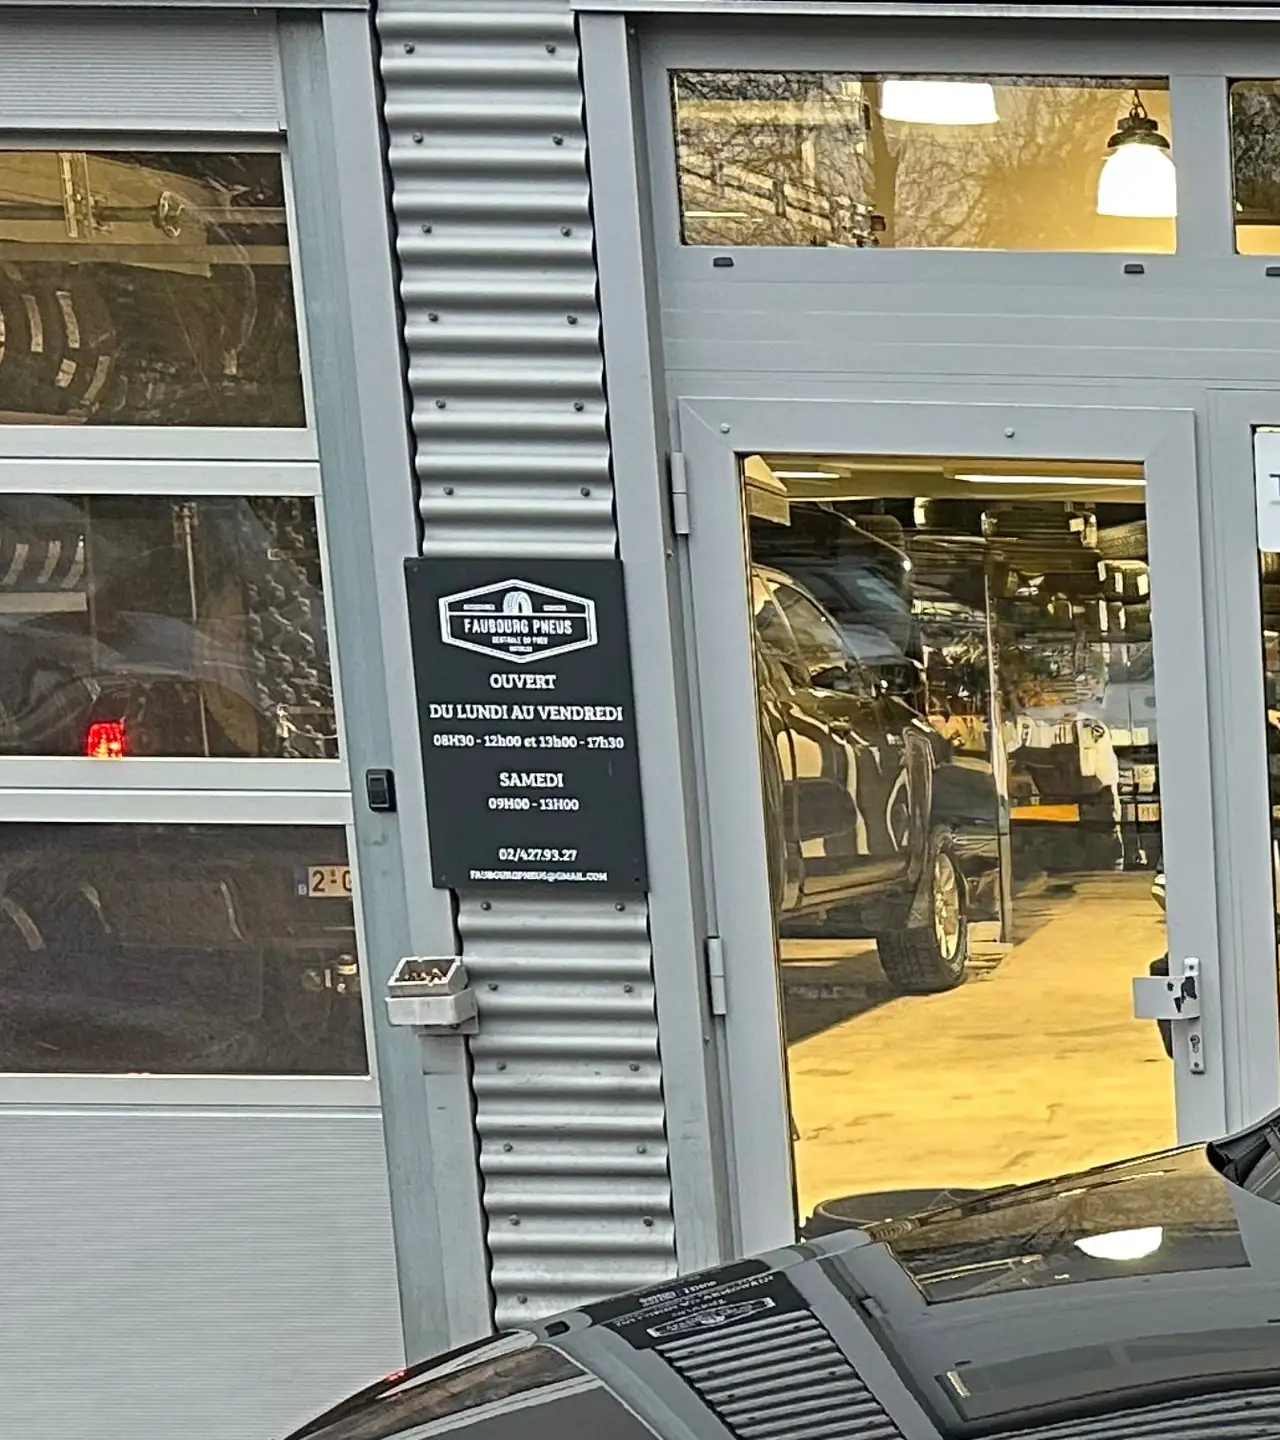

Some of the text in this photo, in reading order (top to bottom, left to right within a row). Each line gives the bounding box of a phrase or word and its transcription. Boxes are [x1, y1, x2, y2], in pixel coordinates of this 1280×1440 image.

[463, 618, 572, 634] FAUBOURG PNEUS
[489, 673, 557, 690] OUVERT
[429, 703, 624, 722] DU LUNDI AU VENDREDI
[433, 734, 474, 747] 08H30
[484, 734, 522, 747] 12h00
[524, 737, 537, 747] et
[540, 735, 577, 748] 13h00
[587, 736, 625, 749] 17h30
[499, 772, 564, 788] SAMEDI
[488, 797, 530, 810] 09H00
[540, 798, 580, 811] 13H00
[499, 848, 578, 862] 02/427.93.27
